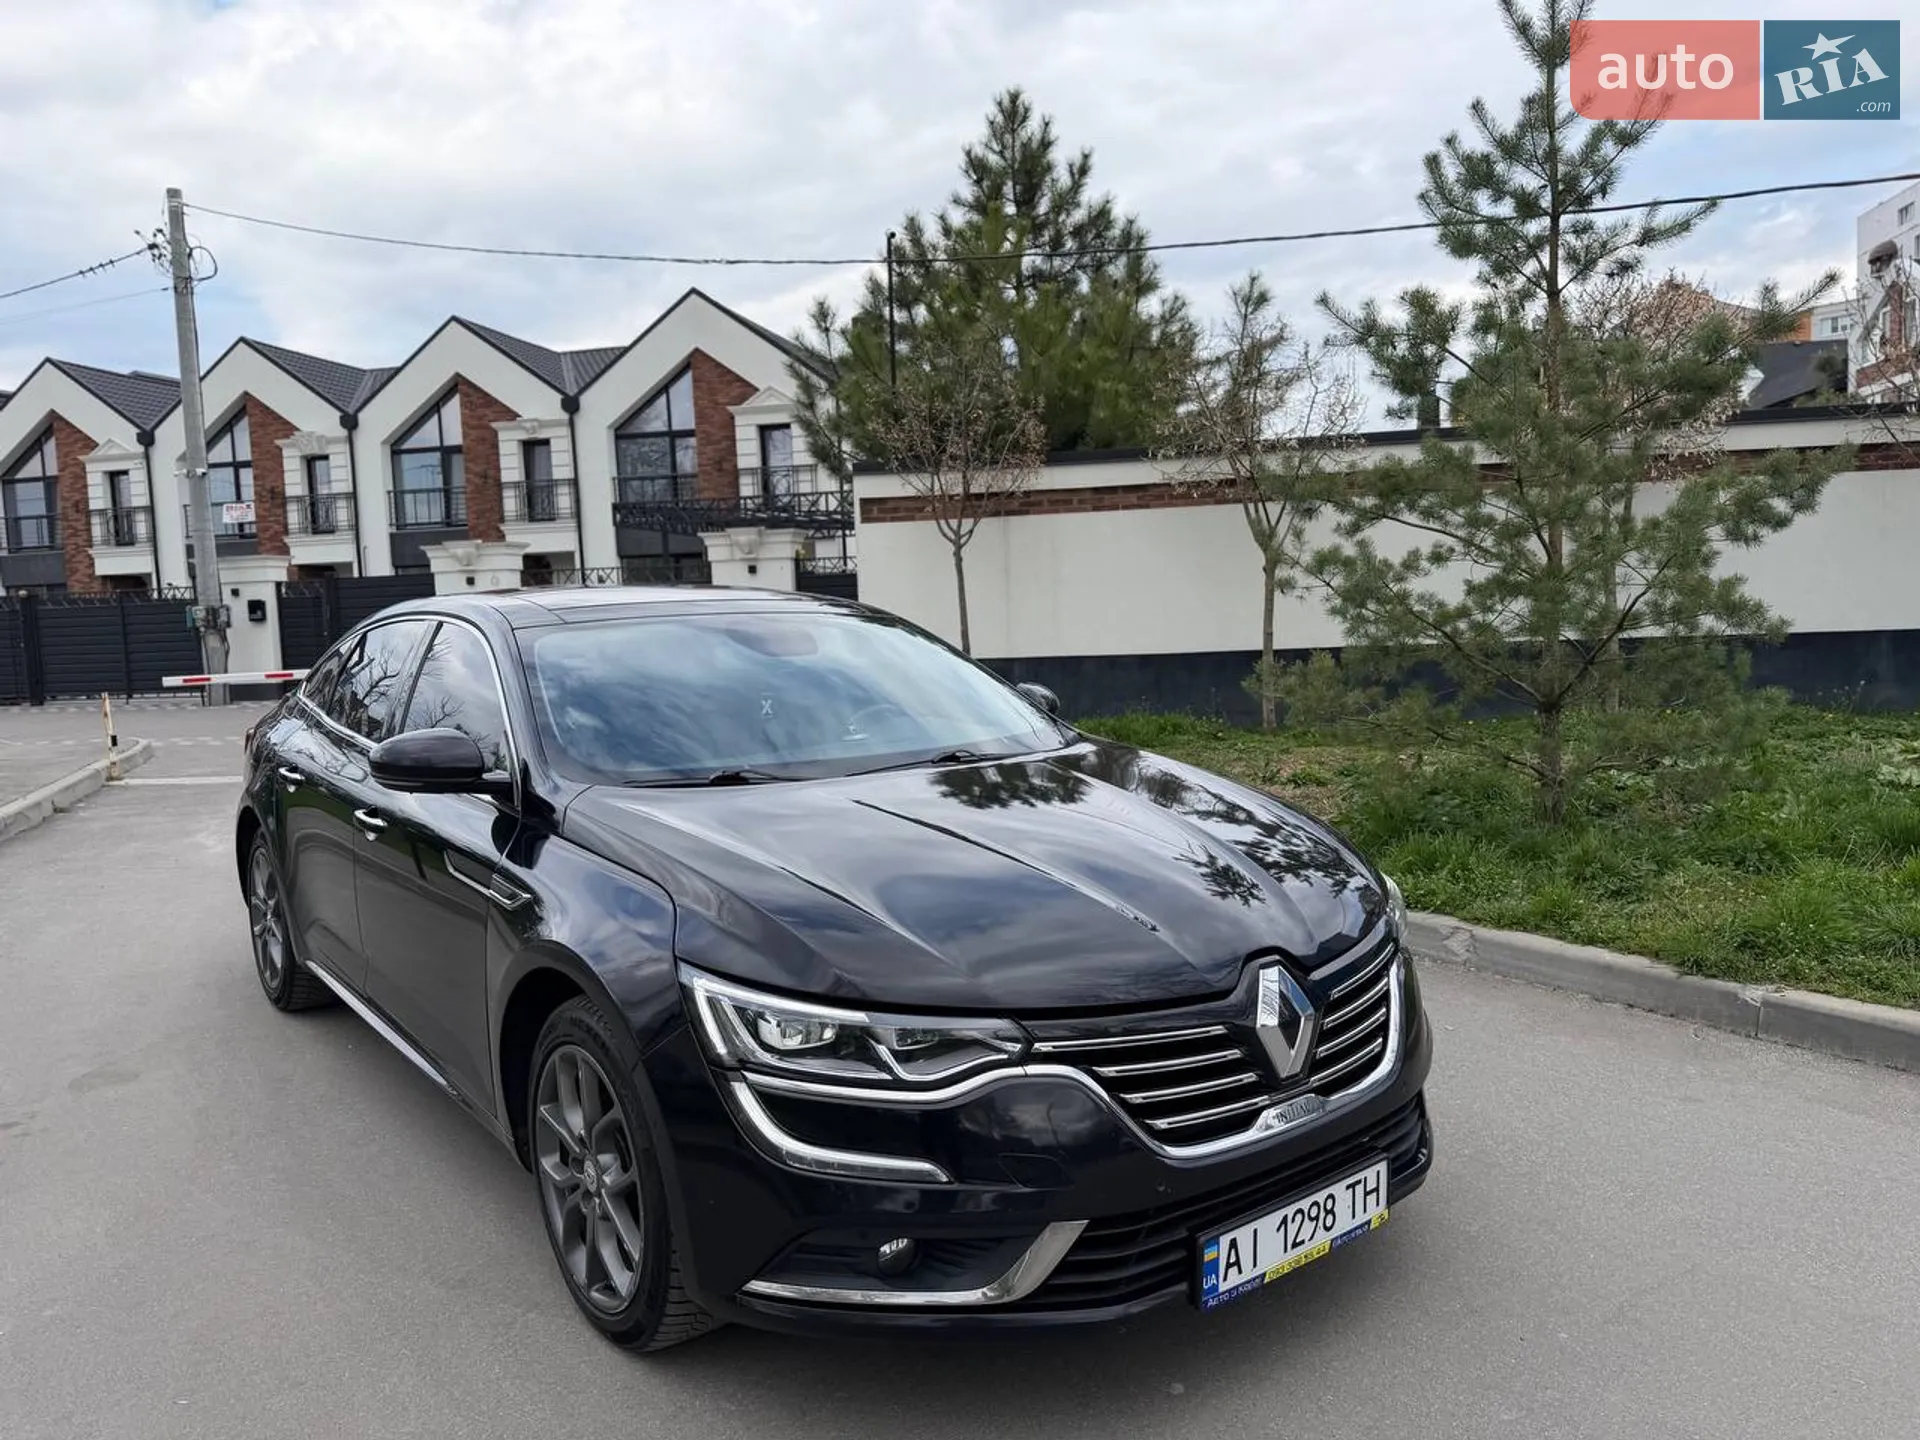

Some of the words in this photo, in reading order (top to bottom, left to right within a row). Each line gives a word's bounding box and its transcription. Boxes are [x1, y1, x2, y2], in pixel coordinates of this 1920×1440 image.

[1222, 1228, 1258, 1283] AI
[1276, 1193, 1336, 1254] 1298
[1346, 1169, 1381, 1220] TH
[1203, 1274, 1217, 1289] UA
